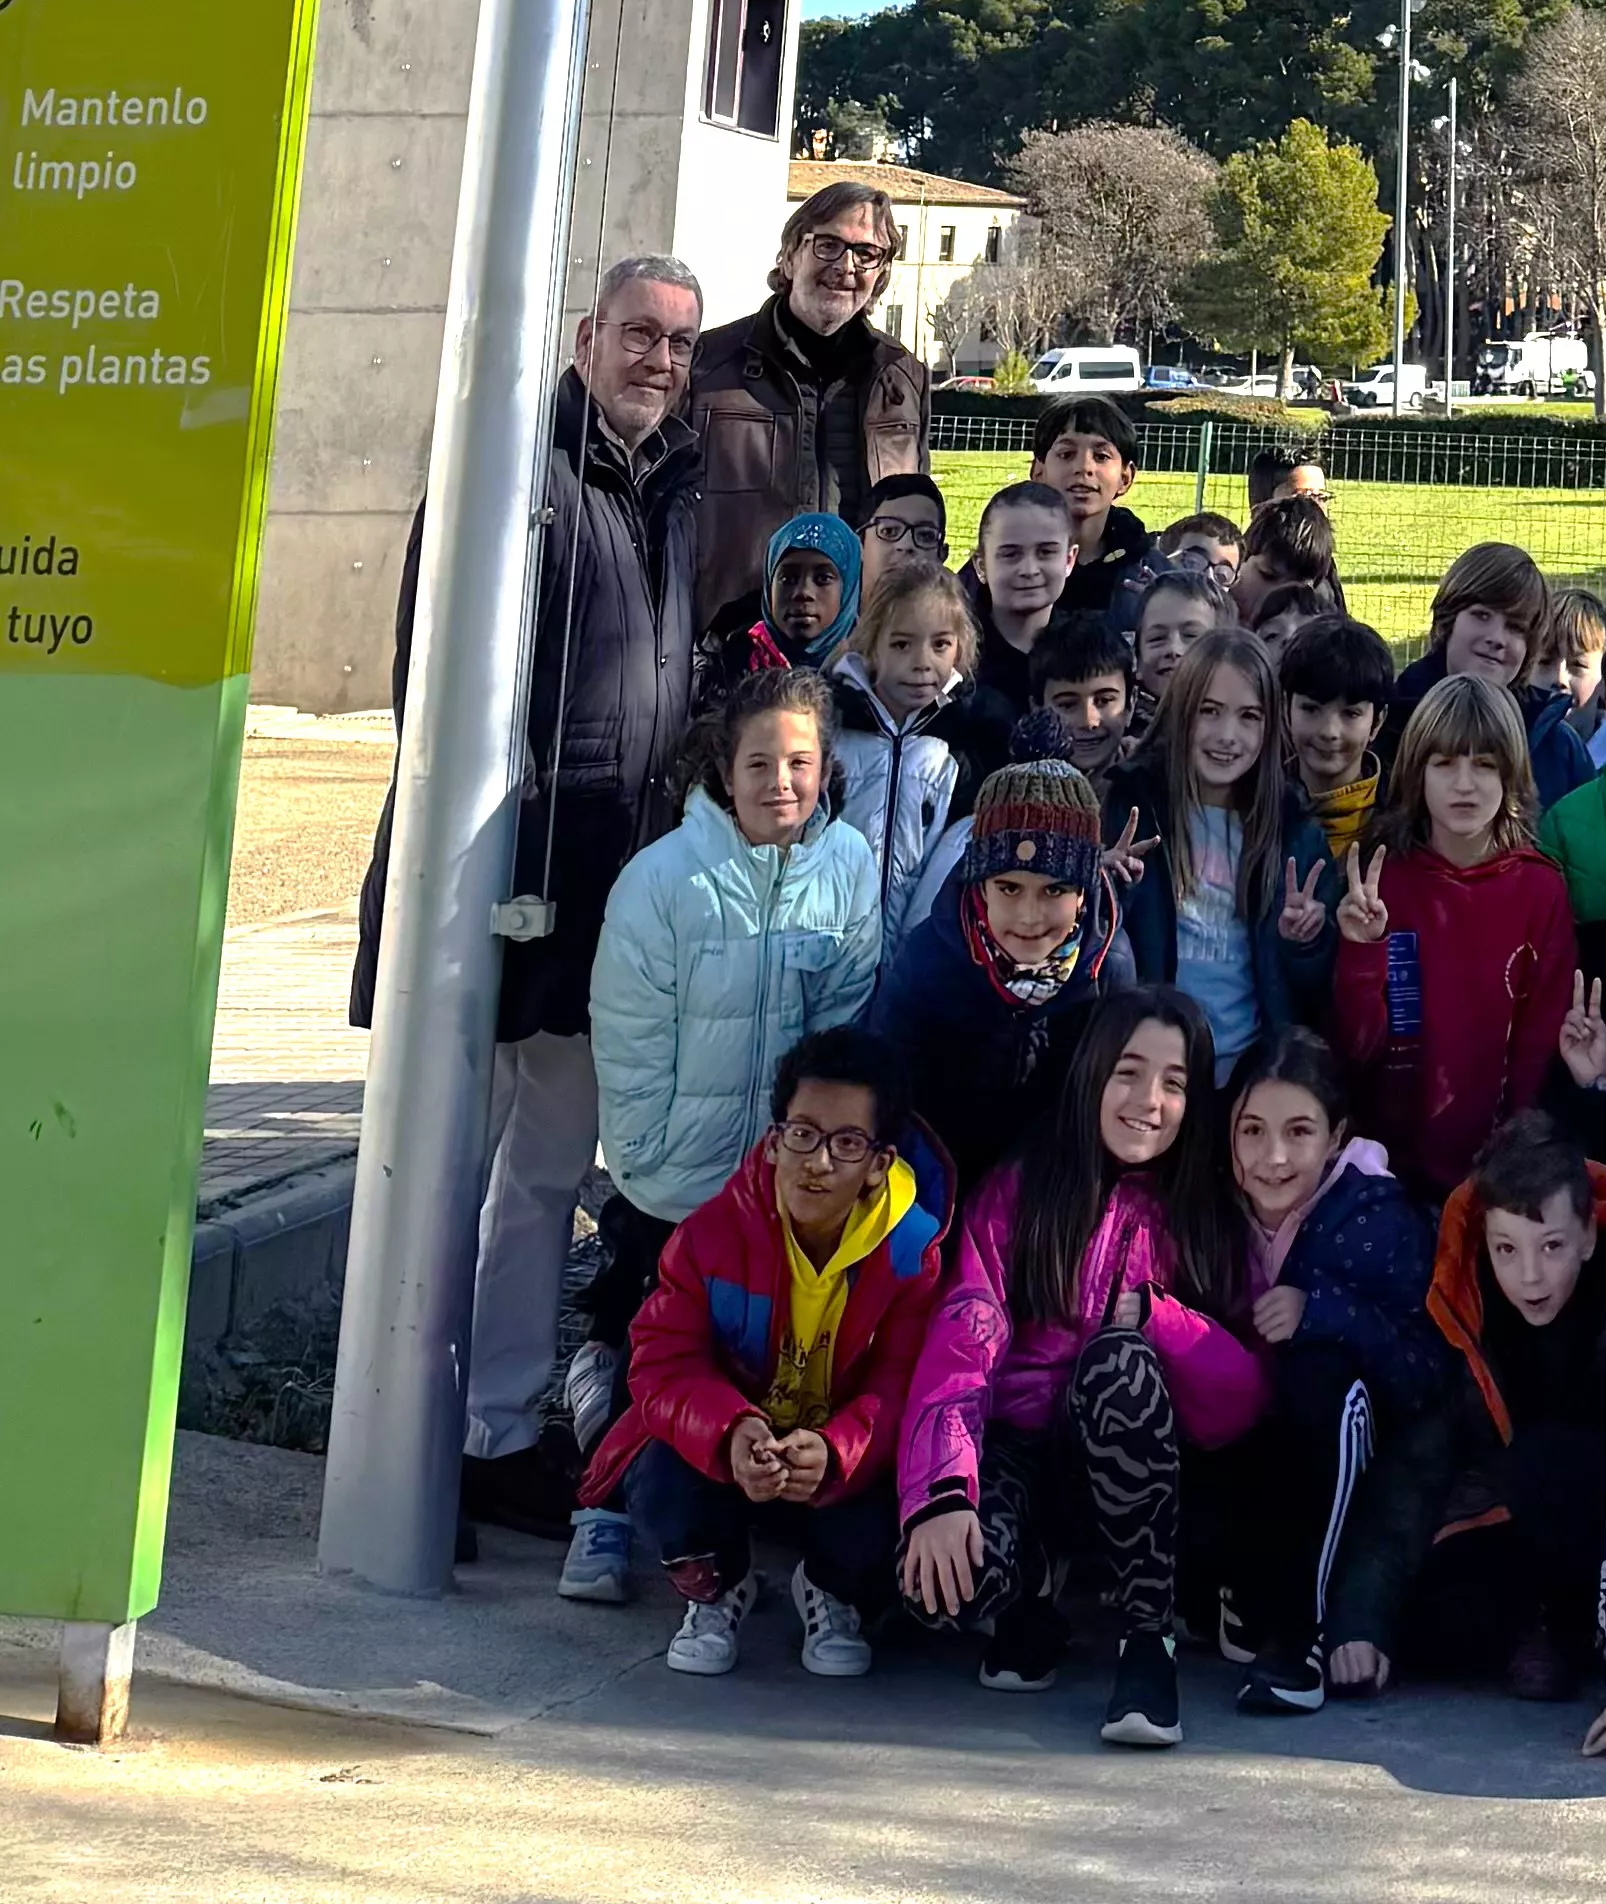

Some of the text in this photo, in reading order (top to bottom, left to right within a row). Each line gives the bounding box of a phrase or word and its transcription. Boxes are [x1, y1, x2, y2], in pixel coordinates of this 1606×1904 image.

[21, 87, 208, 127] Mantenlo
[12, 151, 137, 200] limpio
[0, 279, 160, 328] Respeta
[59, 344, 212, 395] plantas
[8, 606, 93, 655] tuyo
